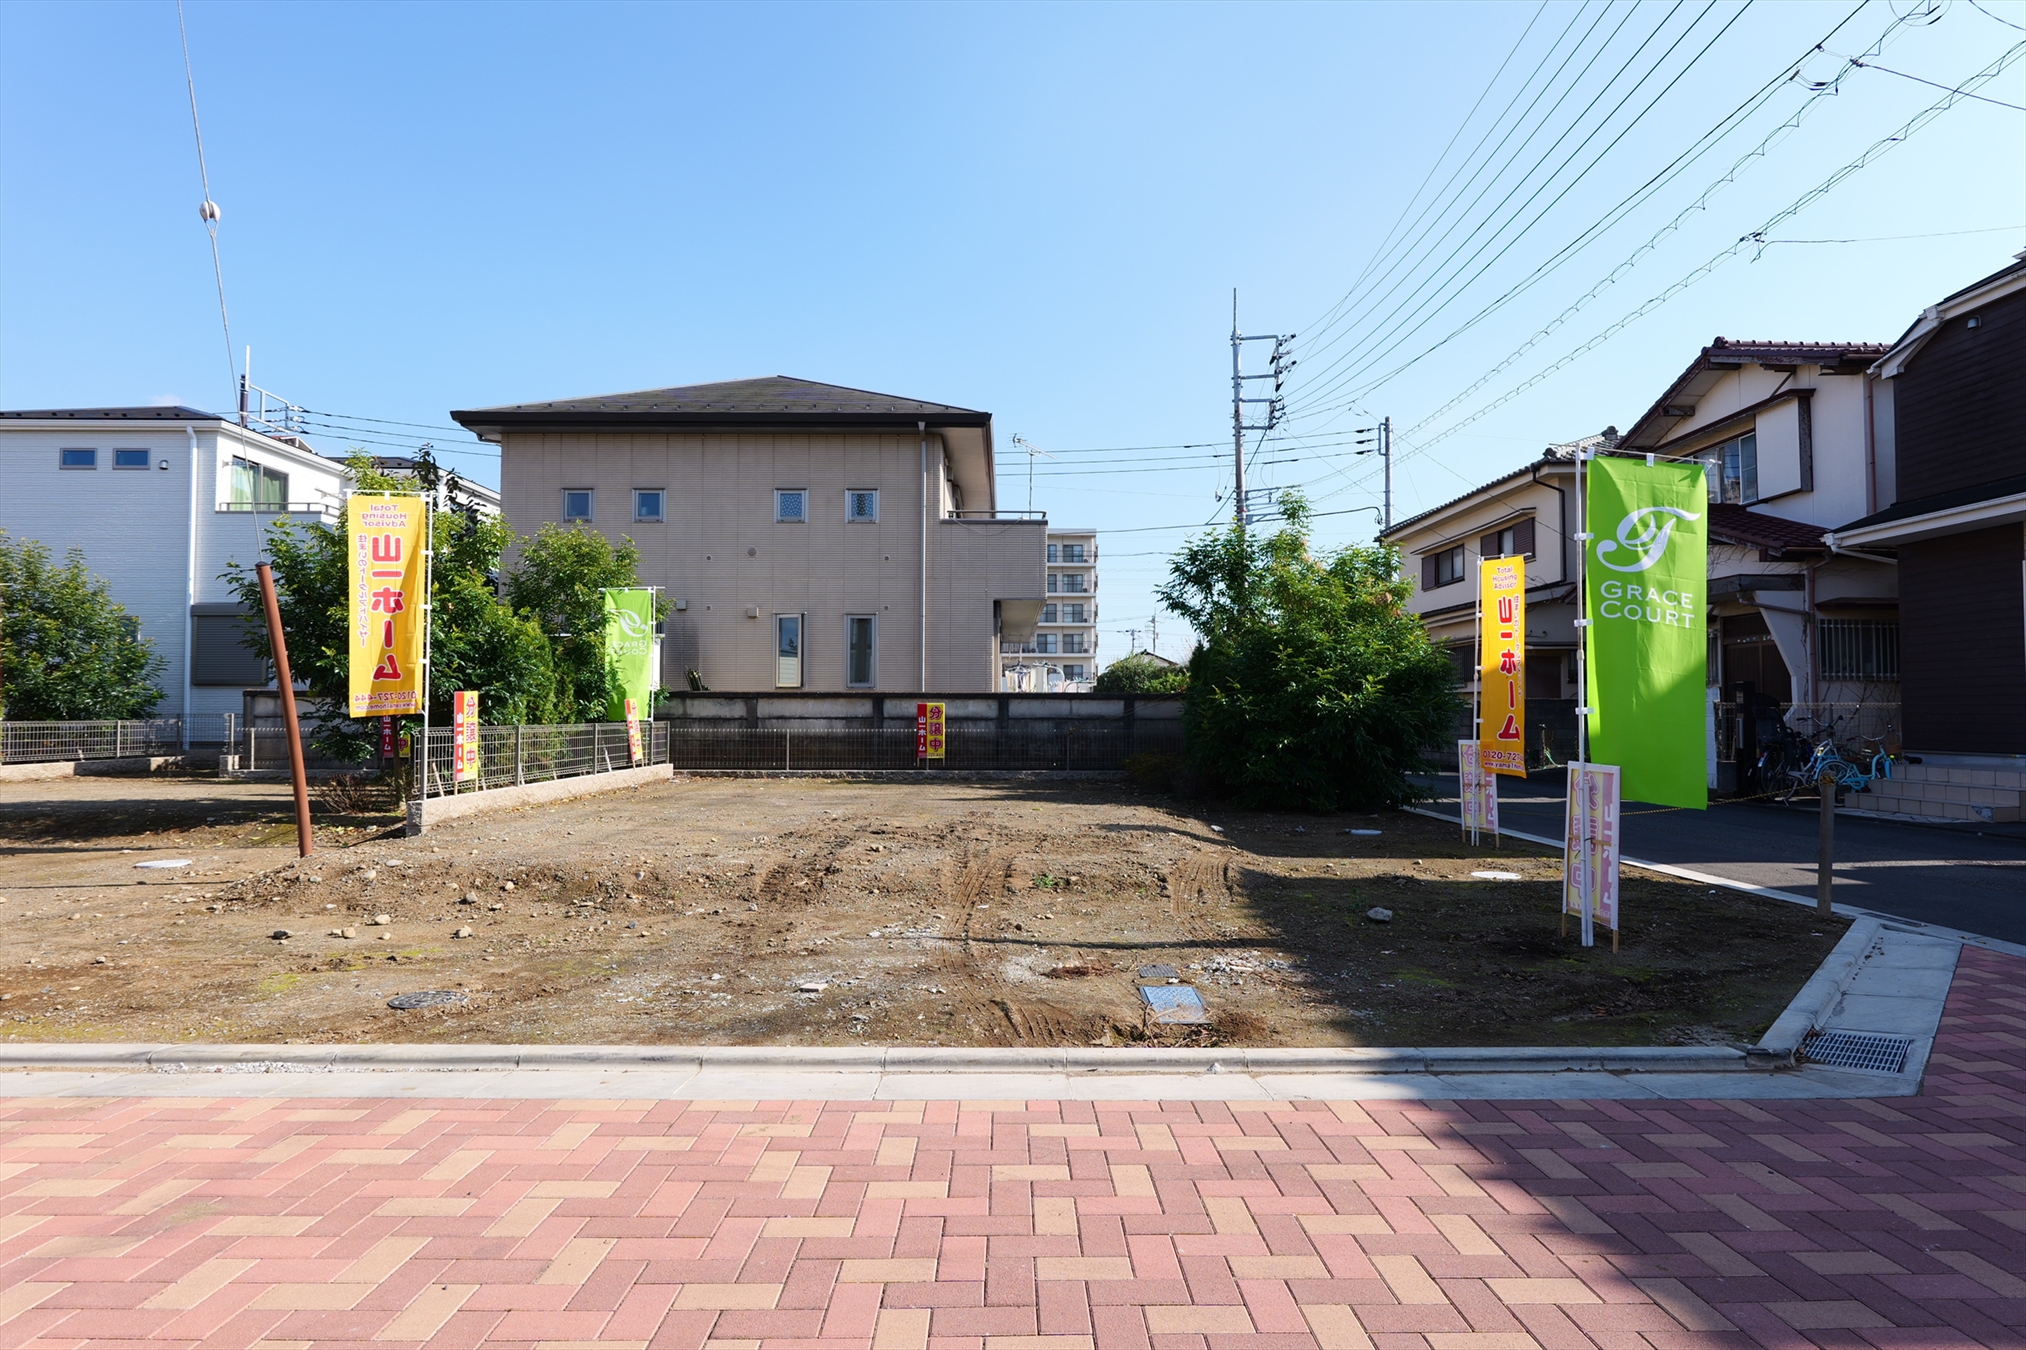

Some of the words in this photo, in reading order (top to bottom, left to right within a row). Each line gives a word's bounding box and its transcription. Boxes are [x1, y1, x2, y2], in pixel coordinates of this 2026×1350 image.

[1492, 574, 1517, 582] Housing
[1494, 582, 1516, 590] Advisor
[1497, 566, 1512, 574] Total
[1600, 580, 1693, 609] GRACE
[1600, 600, 1695, 629] COURT
[1498, 596, 1520, 742] 山一ホーム
[456, 712, 464, 770] 山一ホーム
[466, 696, 477, 769] 分譲中
[918, 716, 926, 751] 山一ホーム
[929, 705, 943, 752] 分譲中
